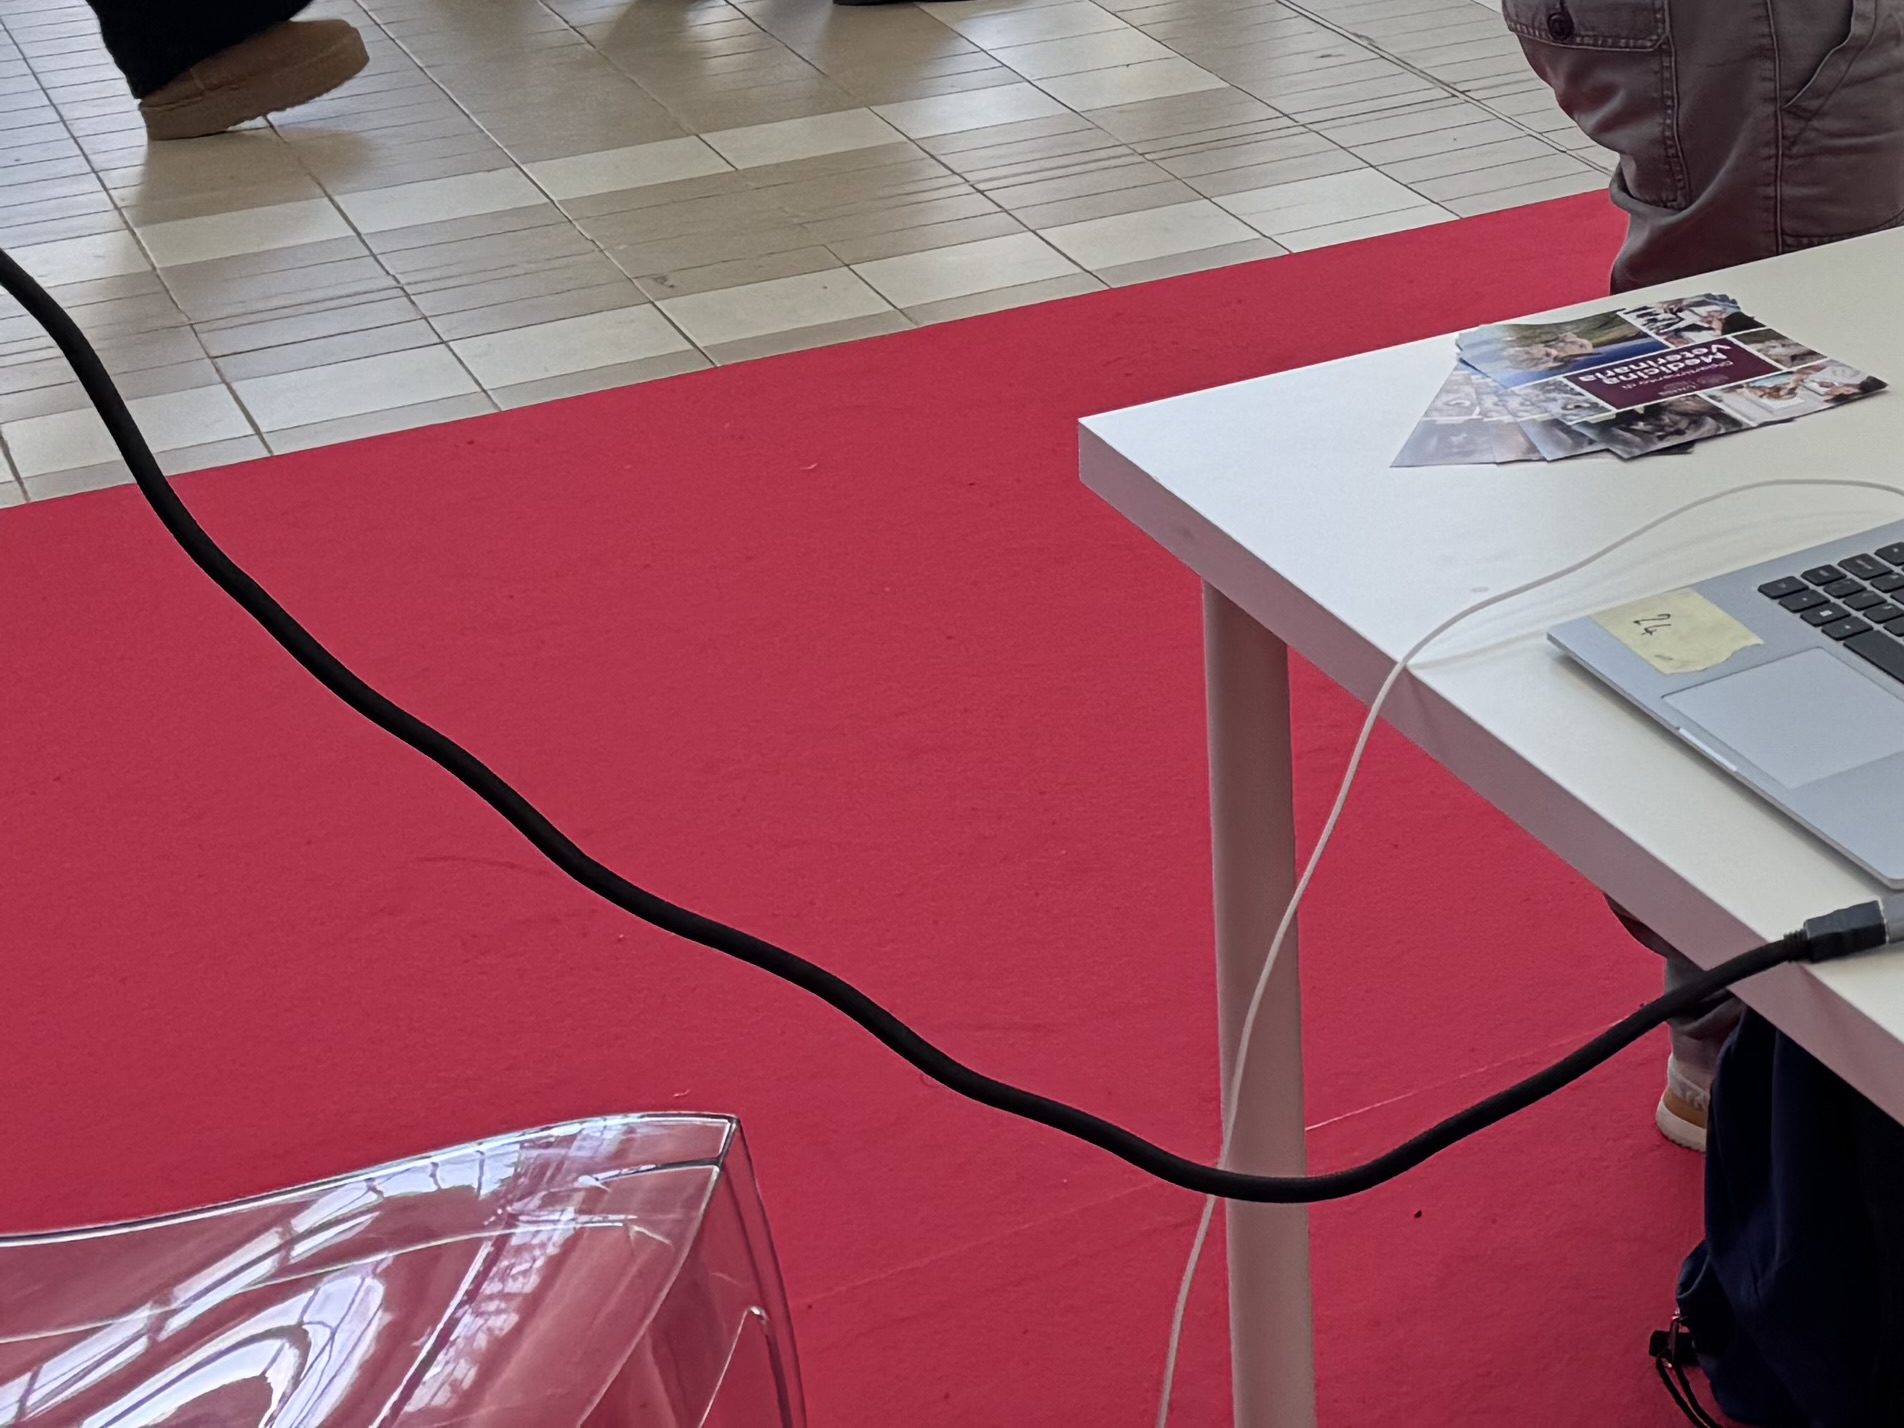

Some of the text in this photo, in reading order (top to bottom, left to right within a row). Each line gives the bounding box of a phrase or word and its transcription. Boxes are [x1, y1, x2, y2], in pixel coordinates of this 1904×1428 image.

[1578, 344, 1732, 382] Veterinaria
[1602, 352, 1728, 386] Medicina
[1633, 613, 1672, 636] 24
